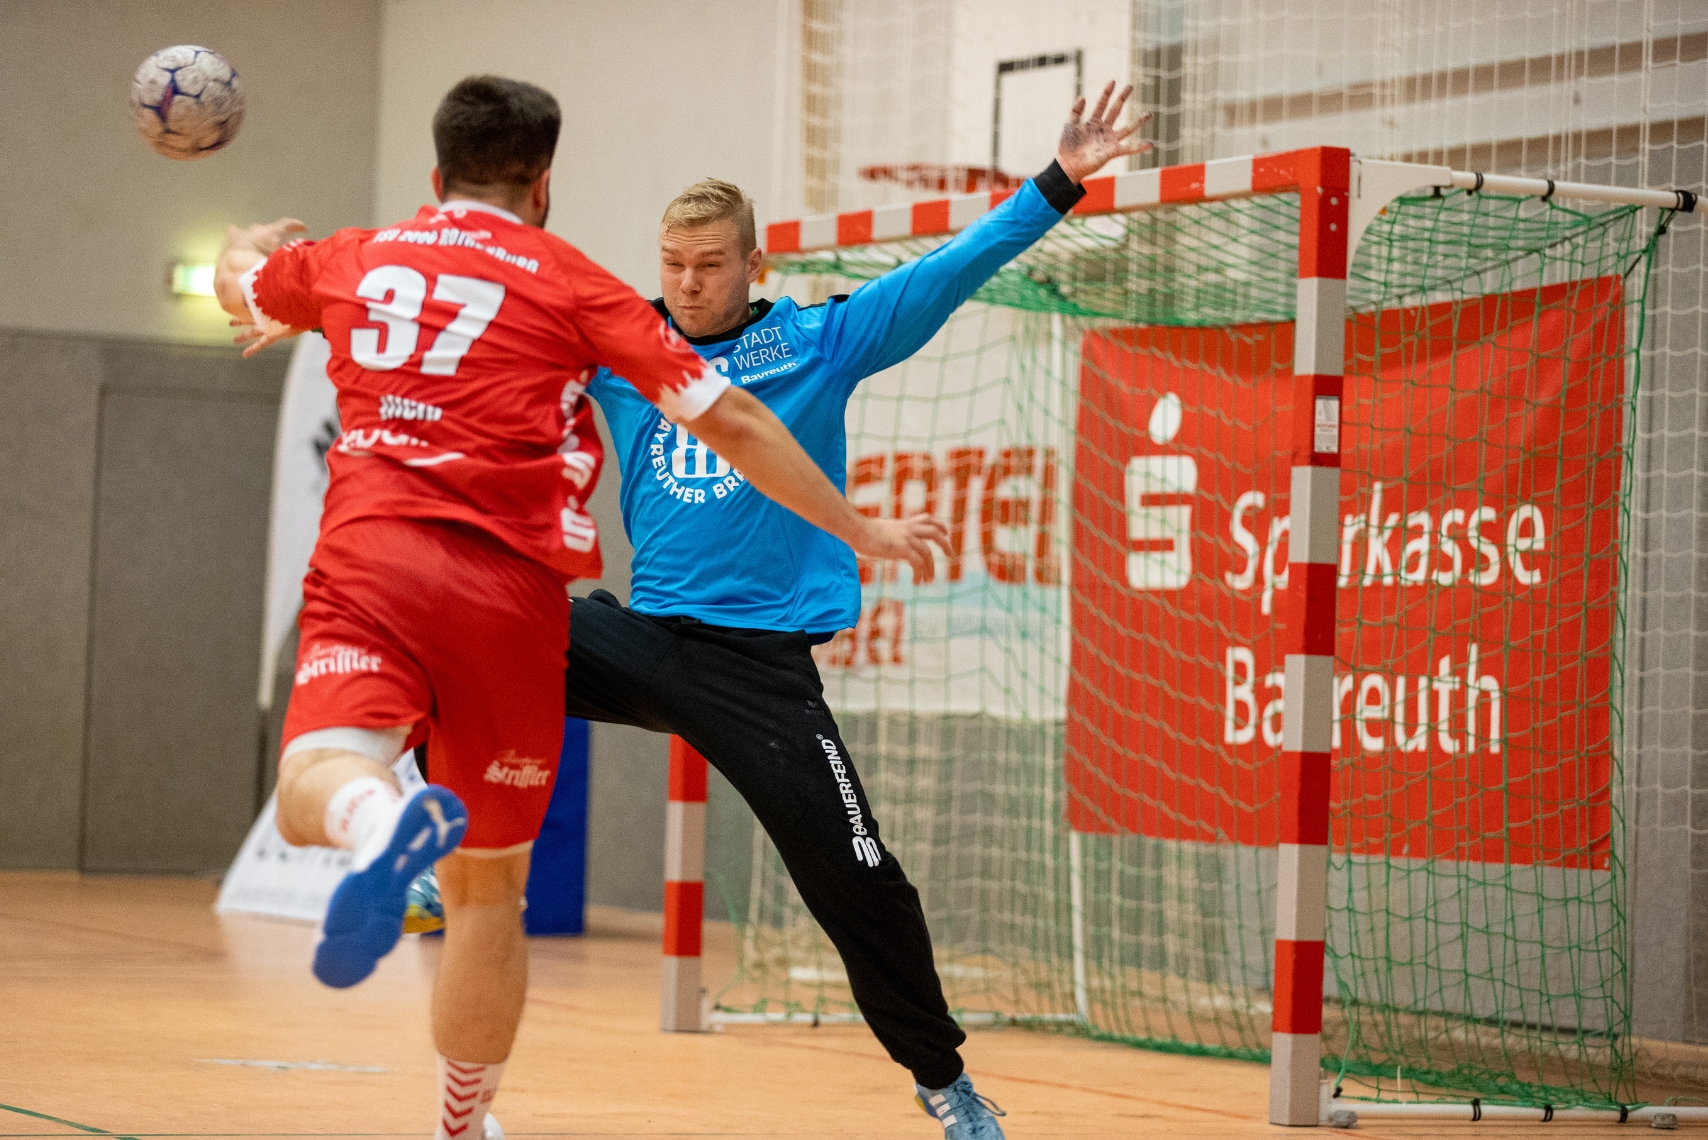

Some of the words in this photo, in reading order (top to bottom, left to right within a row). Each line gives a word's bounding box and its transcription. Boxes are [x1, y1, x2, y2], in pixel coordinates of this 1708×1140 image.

[351, 265, 506, 376] 37
[733, 342, 792, 371] WERKE
[650, 417, 706, 504] AYREUTHER
[1224, 481, 1546, 616] Sprkasse
[1223, 643, 1501, 754] Bareuth
